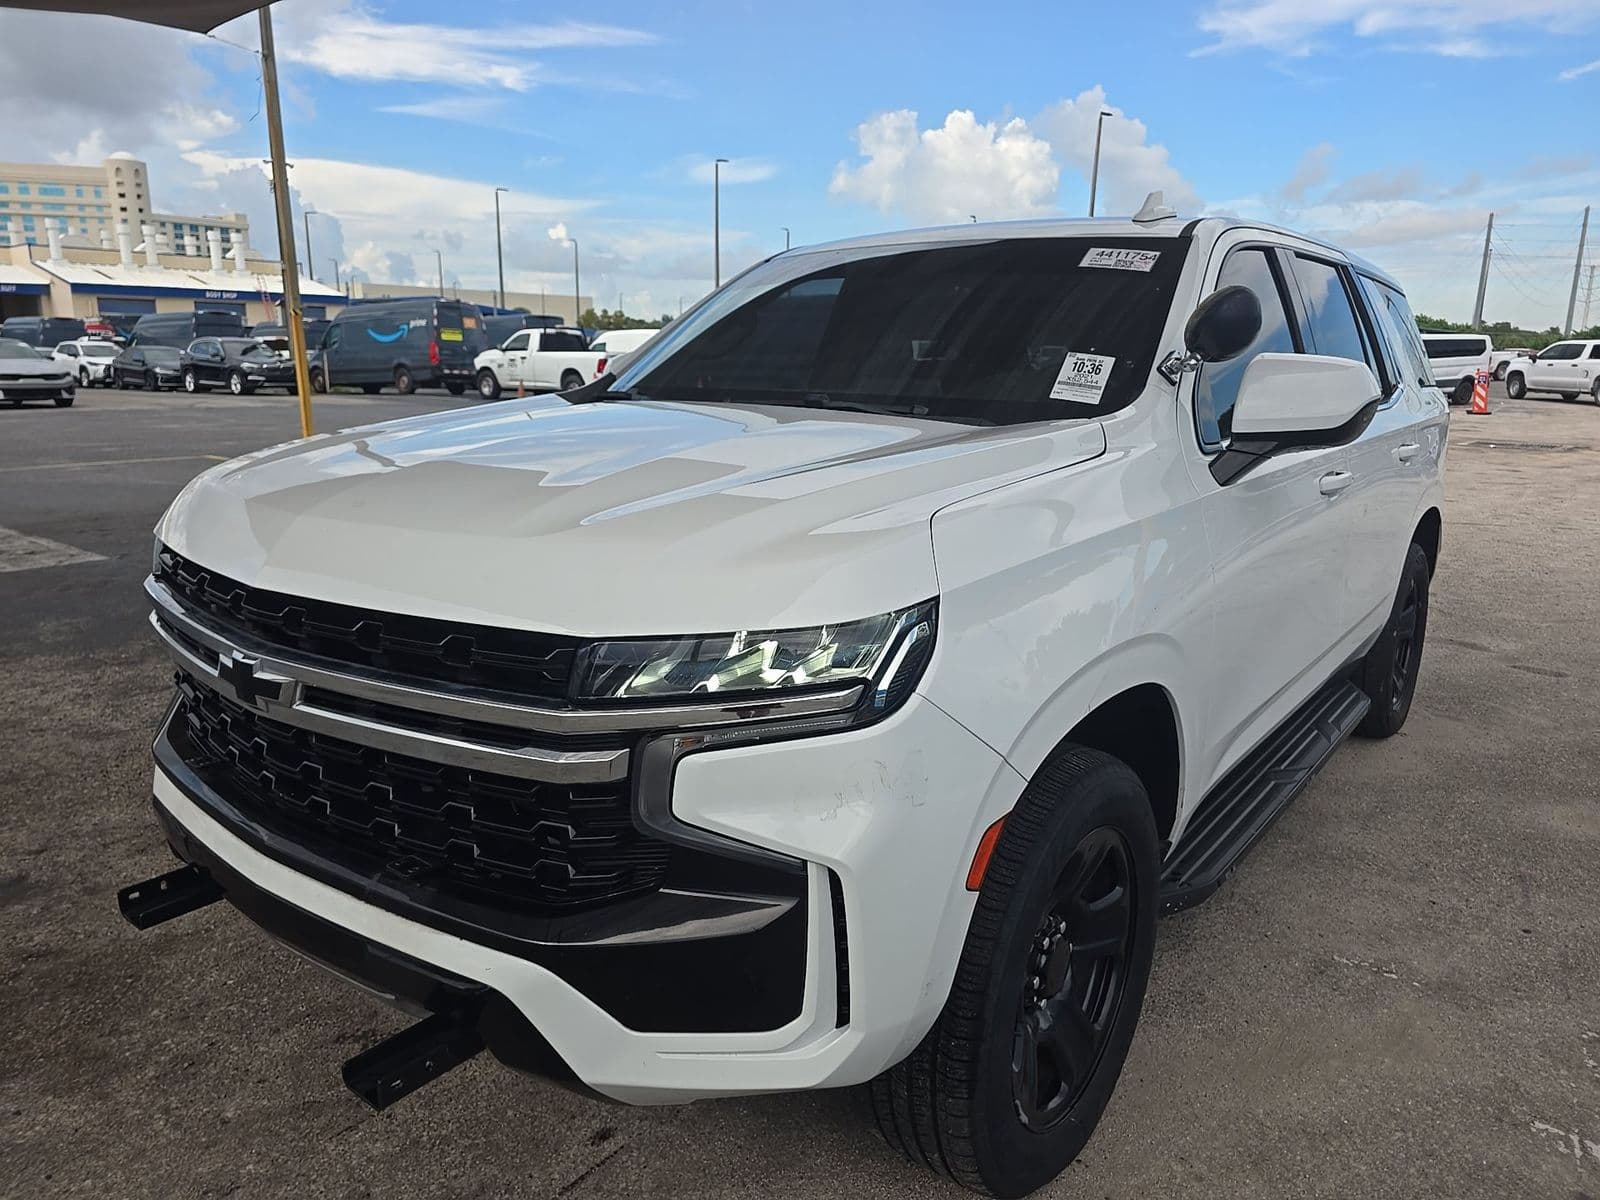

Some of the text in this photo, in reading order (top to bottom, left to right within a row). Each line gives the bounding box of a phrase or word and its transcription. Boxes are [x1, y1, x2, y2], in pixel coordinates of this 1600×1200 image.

[1095, 250, 1158, 261] 4411754
[206, 291, 237, 299] BODY SHOP
[409, 318, 427, 328] prime
[1072, 361, 1103, 375] 10:36
